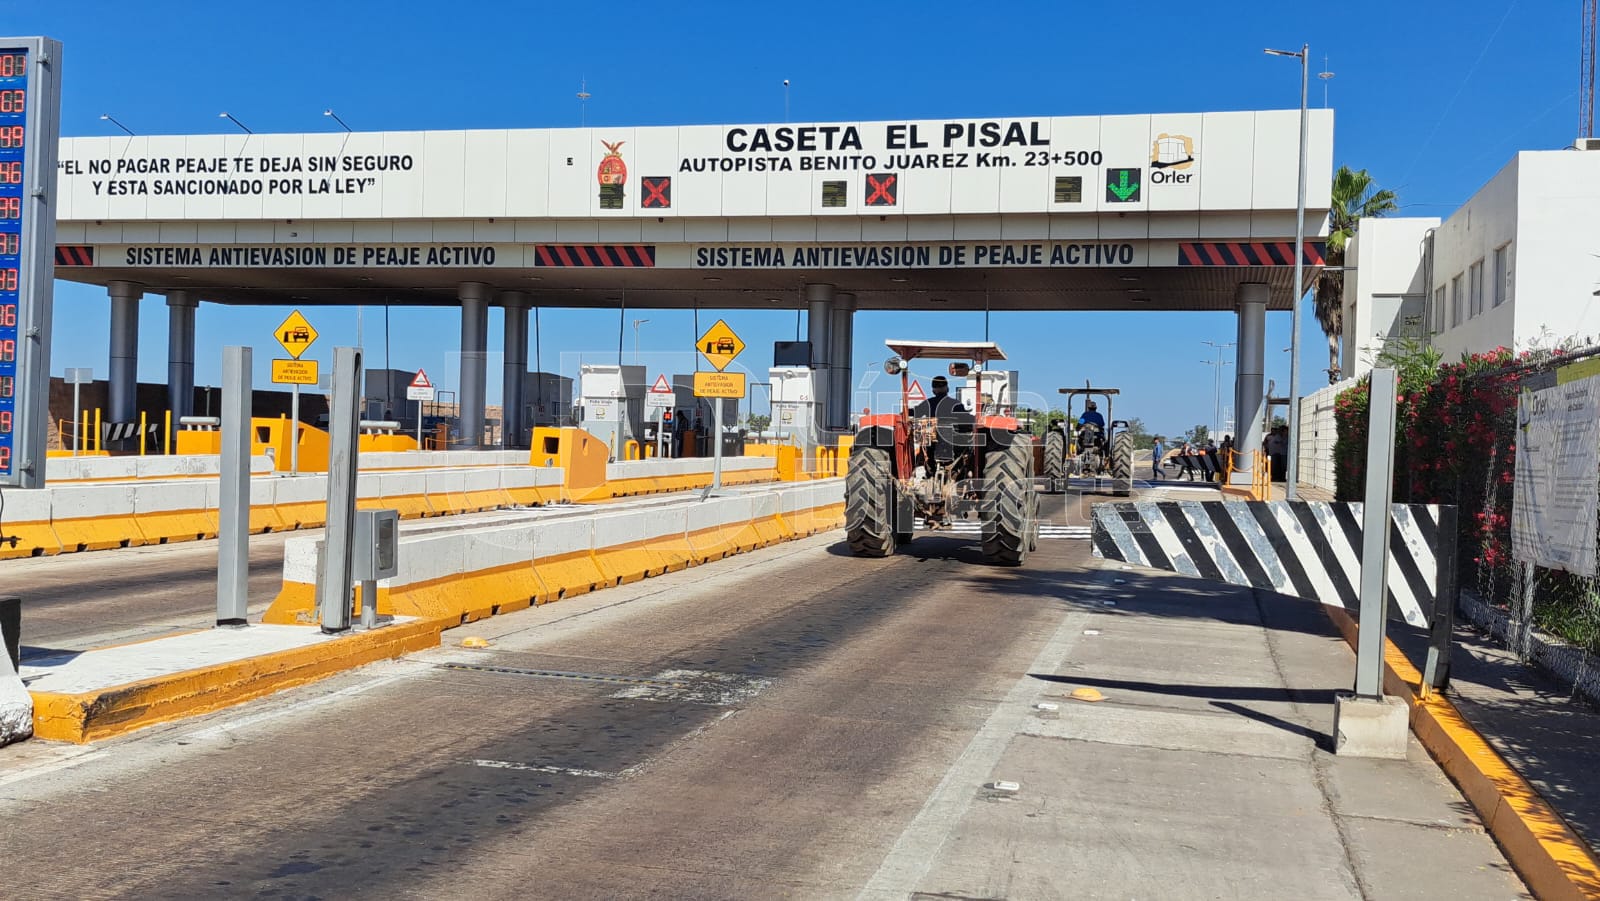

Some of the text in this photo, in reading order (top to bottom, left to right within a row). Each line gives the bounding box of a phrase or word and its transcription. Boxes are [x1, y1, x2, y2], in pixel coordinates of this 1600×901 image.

[726, 122, 1050, 152] CASETA EL PISAL
[89, 159, 111, 174] NO
[117, 158, 170, 173] PAGAR
[176, 158, 228, 173] PEAJE
[233, 157, 254, 172] TE
[260, 157, 303, 172] DEJA
[308, 156, 336, 172] SIN
[342, 155, 413, 171] SEGURO
[679, 150, 1103, 172] AUTOPISTA BENITO JUAREZ Km. 23+500
[93, 177, 375, 195] Y ESTA SANCIONADO POR LA LEY”
[1151, 170, 1193, 184] Orler
[126, 246, 496, 266] SISTEMA ANTIEVASION DE PEAJE ACTIVO
[697, 244, 1134, 267] SISTEMA ANTIEVASION DE PEAJE ACTIVO
